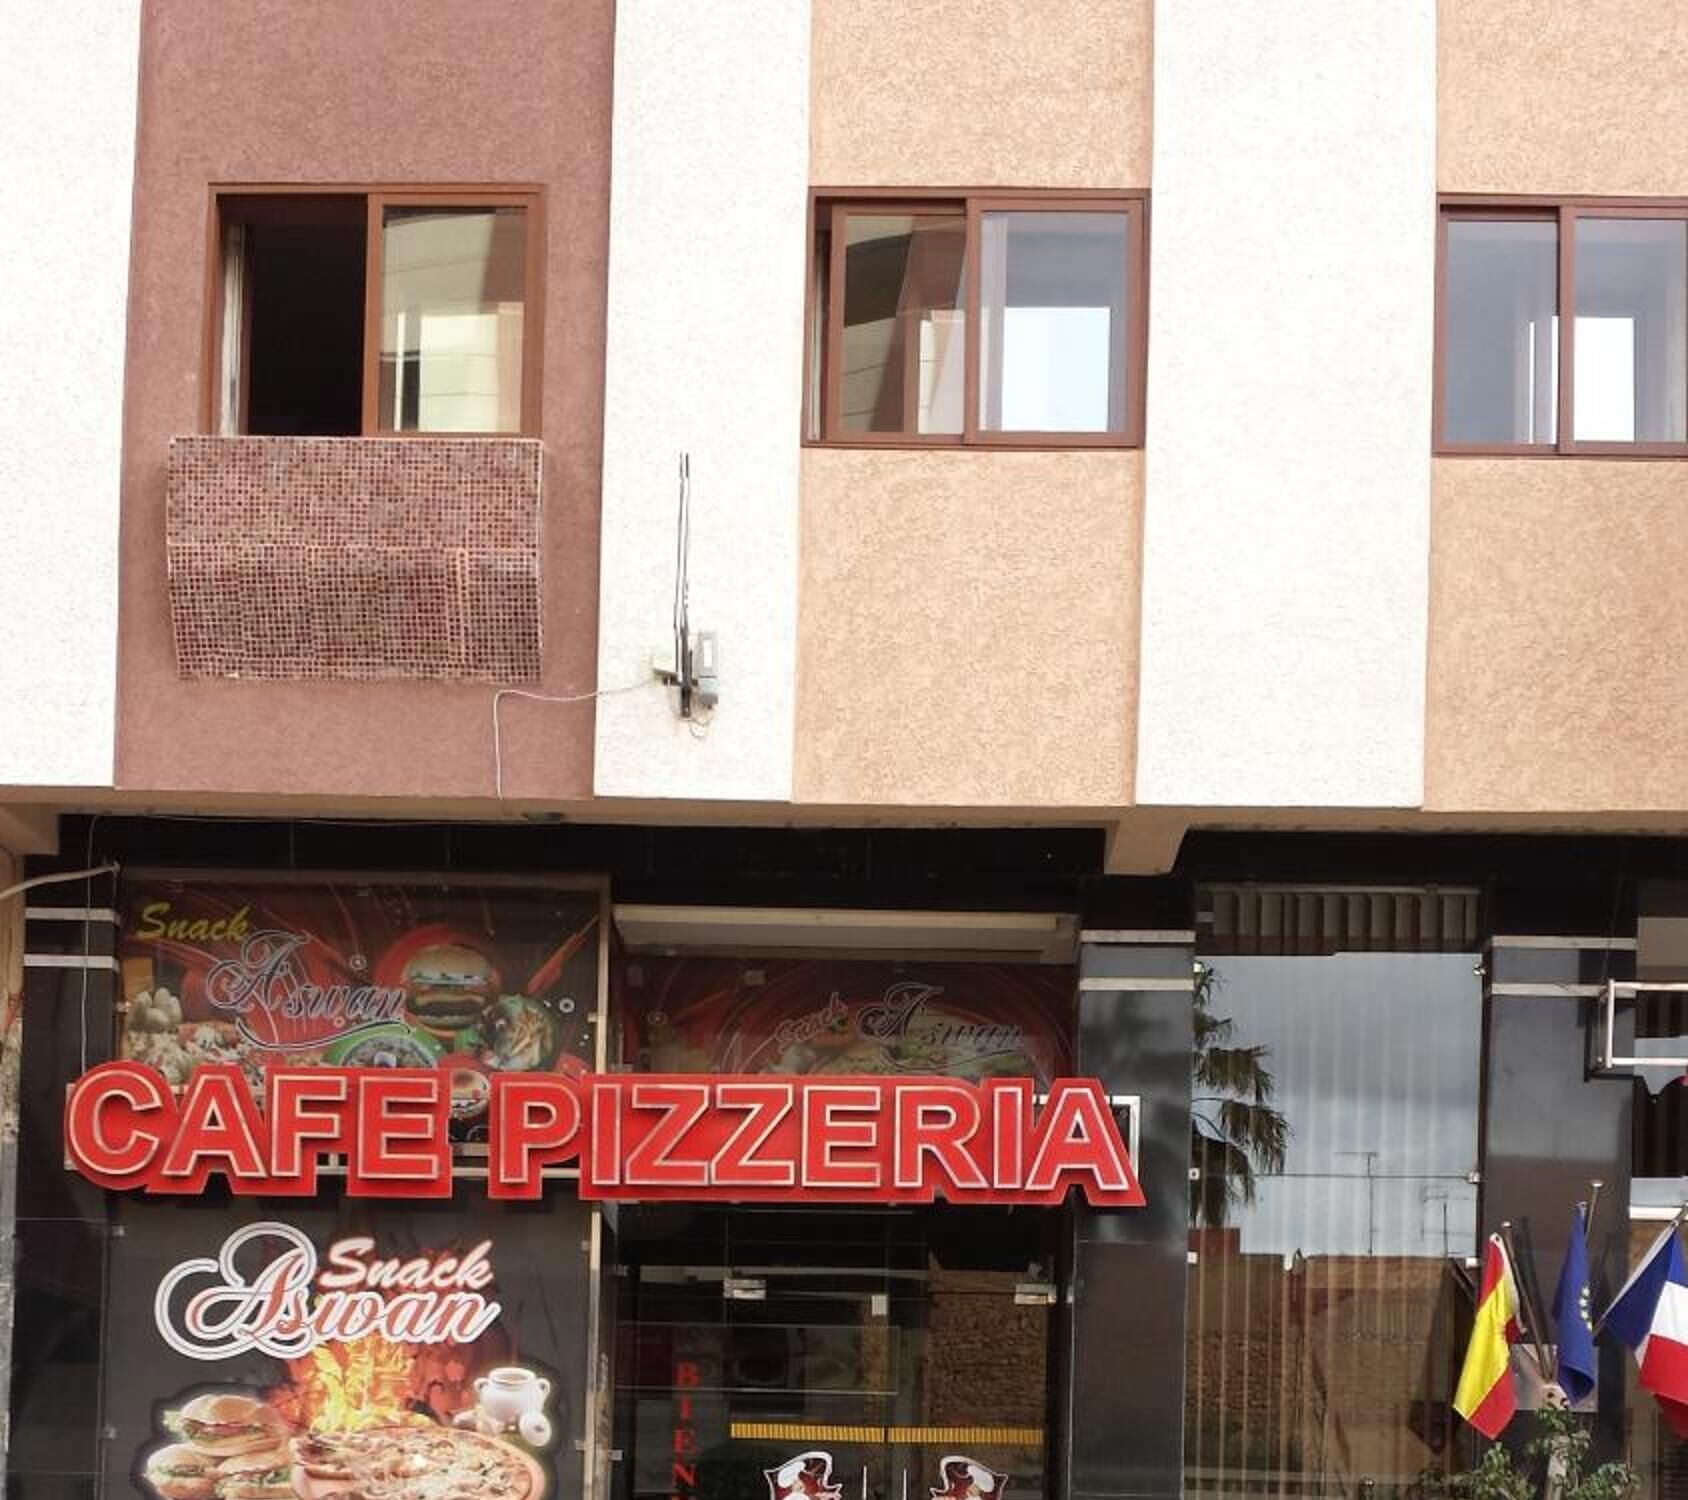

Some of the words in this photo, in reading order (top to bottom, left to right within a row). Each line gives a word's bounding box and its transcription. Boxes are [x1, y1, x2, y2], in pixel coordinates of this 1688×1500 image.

[135, 902, 250, 942] Snack
[65, 1062, 452, 1198] CAFE
[488, 1073, 1146, 1205] PIZZERIA
[154, 1221, 501, 1360] Aswan
[319, 1238, 494, 1289] Snack
